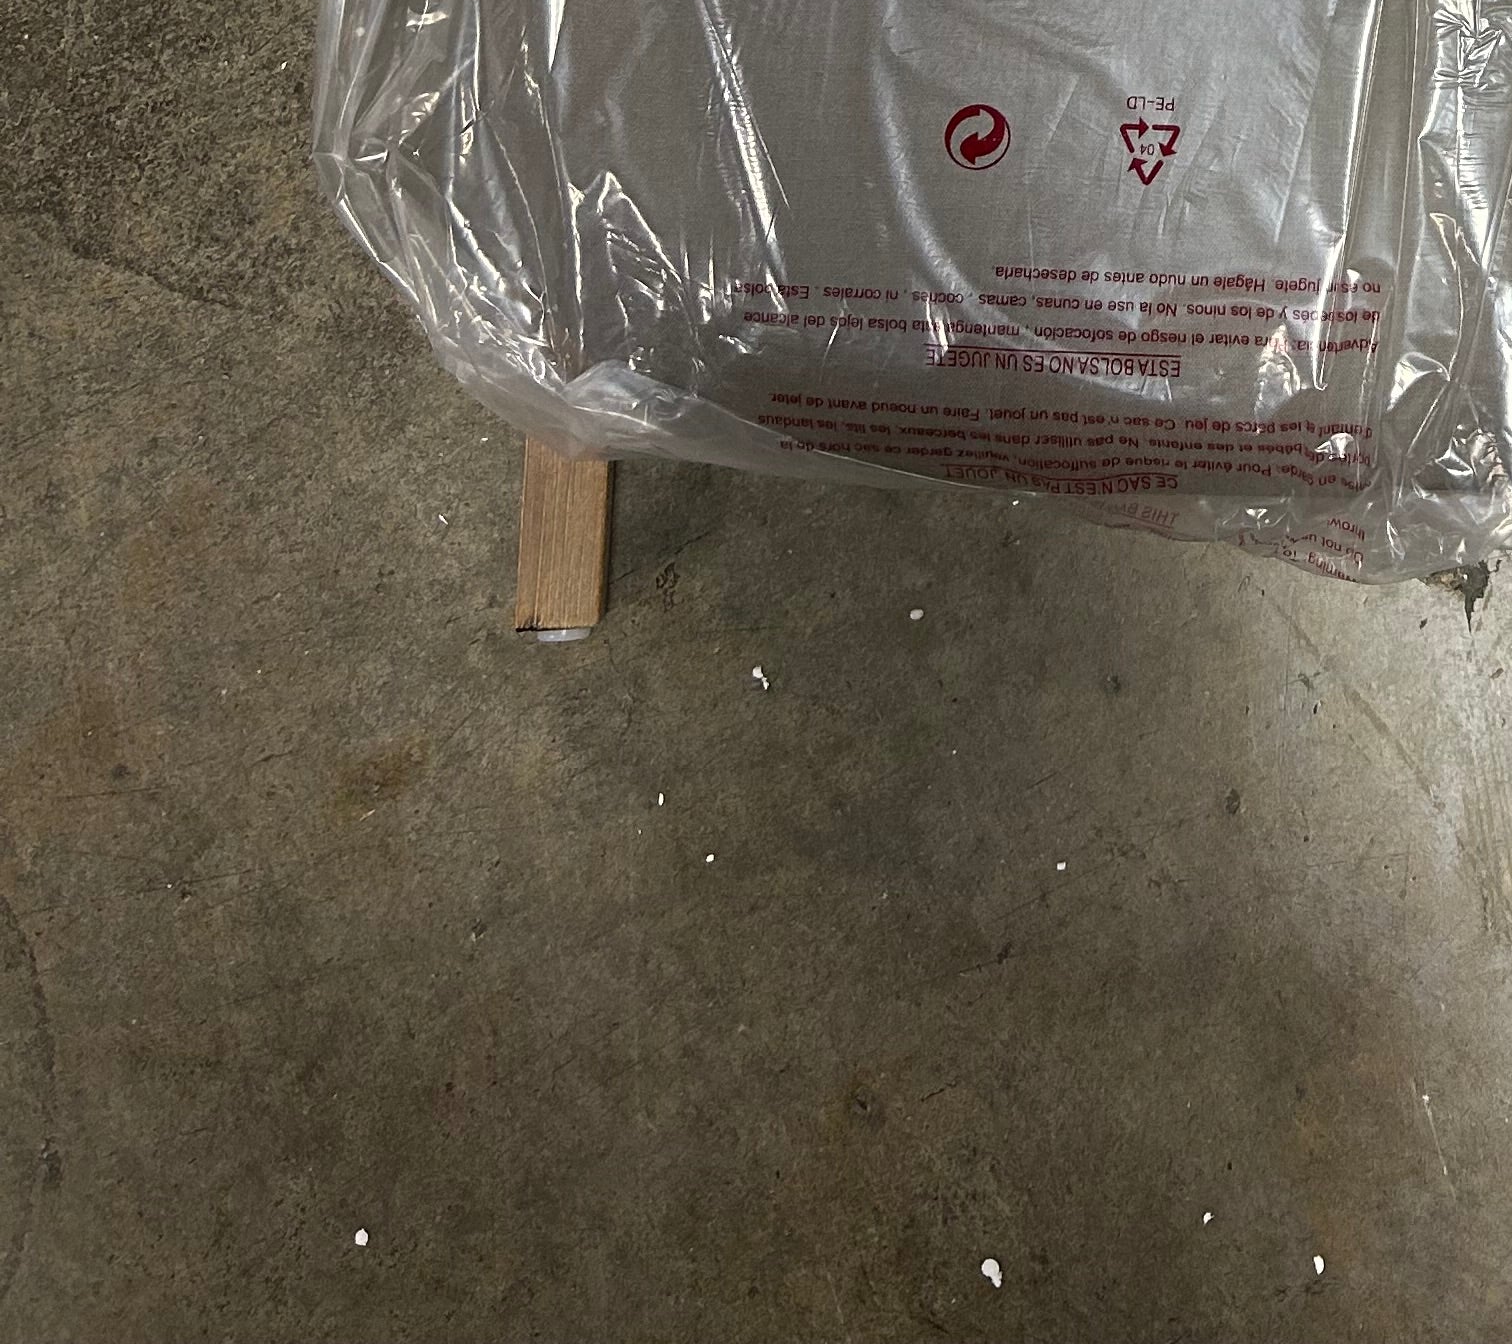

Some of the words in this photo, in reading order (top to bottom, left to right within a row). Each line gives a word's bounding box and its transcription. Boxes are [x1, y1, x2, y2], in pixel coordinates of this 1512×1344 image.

[1126, 96, 1175, 111] PE-LD
[1140, 144, 1155, 156] 04
[1081, 270, 1099, 284] de
[1103, 271, 1145, 285] antes
[1148, 273, 1186, 288] nudo
[1191, 276, 1209, 288] un
[1213, 273, 1266, 292] Hágale
[777, 285, 810, 300] Esta
[823, 286, 881, 300] corrales
[885, 289, 899, 302] ni
[1362, 283, 1381, 294] no
[978, 293, 1027, 308] camas
[1084, 299, 1104, 312] en
[1108, 300, 1135, 313] use
[1139, 301, 1152, 316] la
[1156, 302, 1178, 317] No
[1230, 306, 1252, 320] los
[1255, 307, 1275, 323] de
[1279, 306, 1288, 321] y
[743, 311, 800, 327] alcance
[804, 314, 826, 328] del
[830, 314, 864, 330] lejos
[1337, 311, 1358, 324] los
[867, 318, 907, 333] bolsa
[1033, 326, 1114, 343] sofocación
[1118, 331, 1136, 345] de
[1191, 333, 1205, 346] el
[1208, 334, 1250, 349] evitar
[925, 349, 991, 369] JUGETE
[994, 351, 1019, 371] UN
[1023, 353, 1045, 373] ES
[1048, 355, 1074, 375] NO
[1076, 355, 1134, 376] BOLSA
[1137, 358, 1181, 378] ESTA
[806, 397, 824, 409] de
[827, 398, 867, 412] avant
[871, 401, 917, 415] noeud
[920, 405, 939, 416] un
[942, 407, 980, 422] Faire
[1030, 410, 1049, 421] un
[1052, 411, 1079, 424] pas
[757, 415, 814, 430] landaus
[816, 419, 838, 433] les
[1123, 416, 1150, 428] sac
[1154, 418, 1176, 431] Ce
[1211, 421, 1231, 433] de
[1279, 421, 1302, 433] les
[869, 424, 891, 436] les
[969, 431, 991, 442] les
[994, 434, 1031, 447] dans
[1034, 435, 1082, 449] utiliser
[1086, 434, 1114, 447] pas
[1118, 436, 1139, 449] Ne
[1207, 443, 1234, 453] des
[1238, 444, 1253, 453] et
[1101, 457, 1121, 468] de
[1124, 455, 1170, 467] risque
[1174, 460, 1188, 470] le
[943, 467, 998, 479] JOUET
[1236, 463, 1272, 477] Pour
[1004, 471, 1027, 484] UN
[1117, 476, 1152, 492] SAC
[1155, 476, 1178, 489] CE
